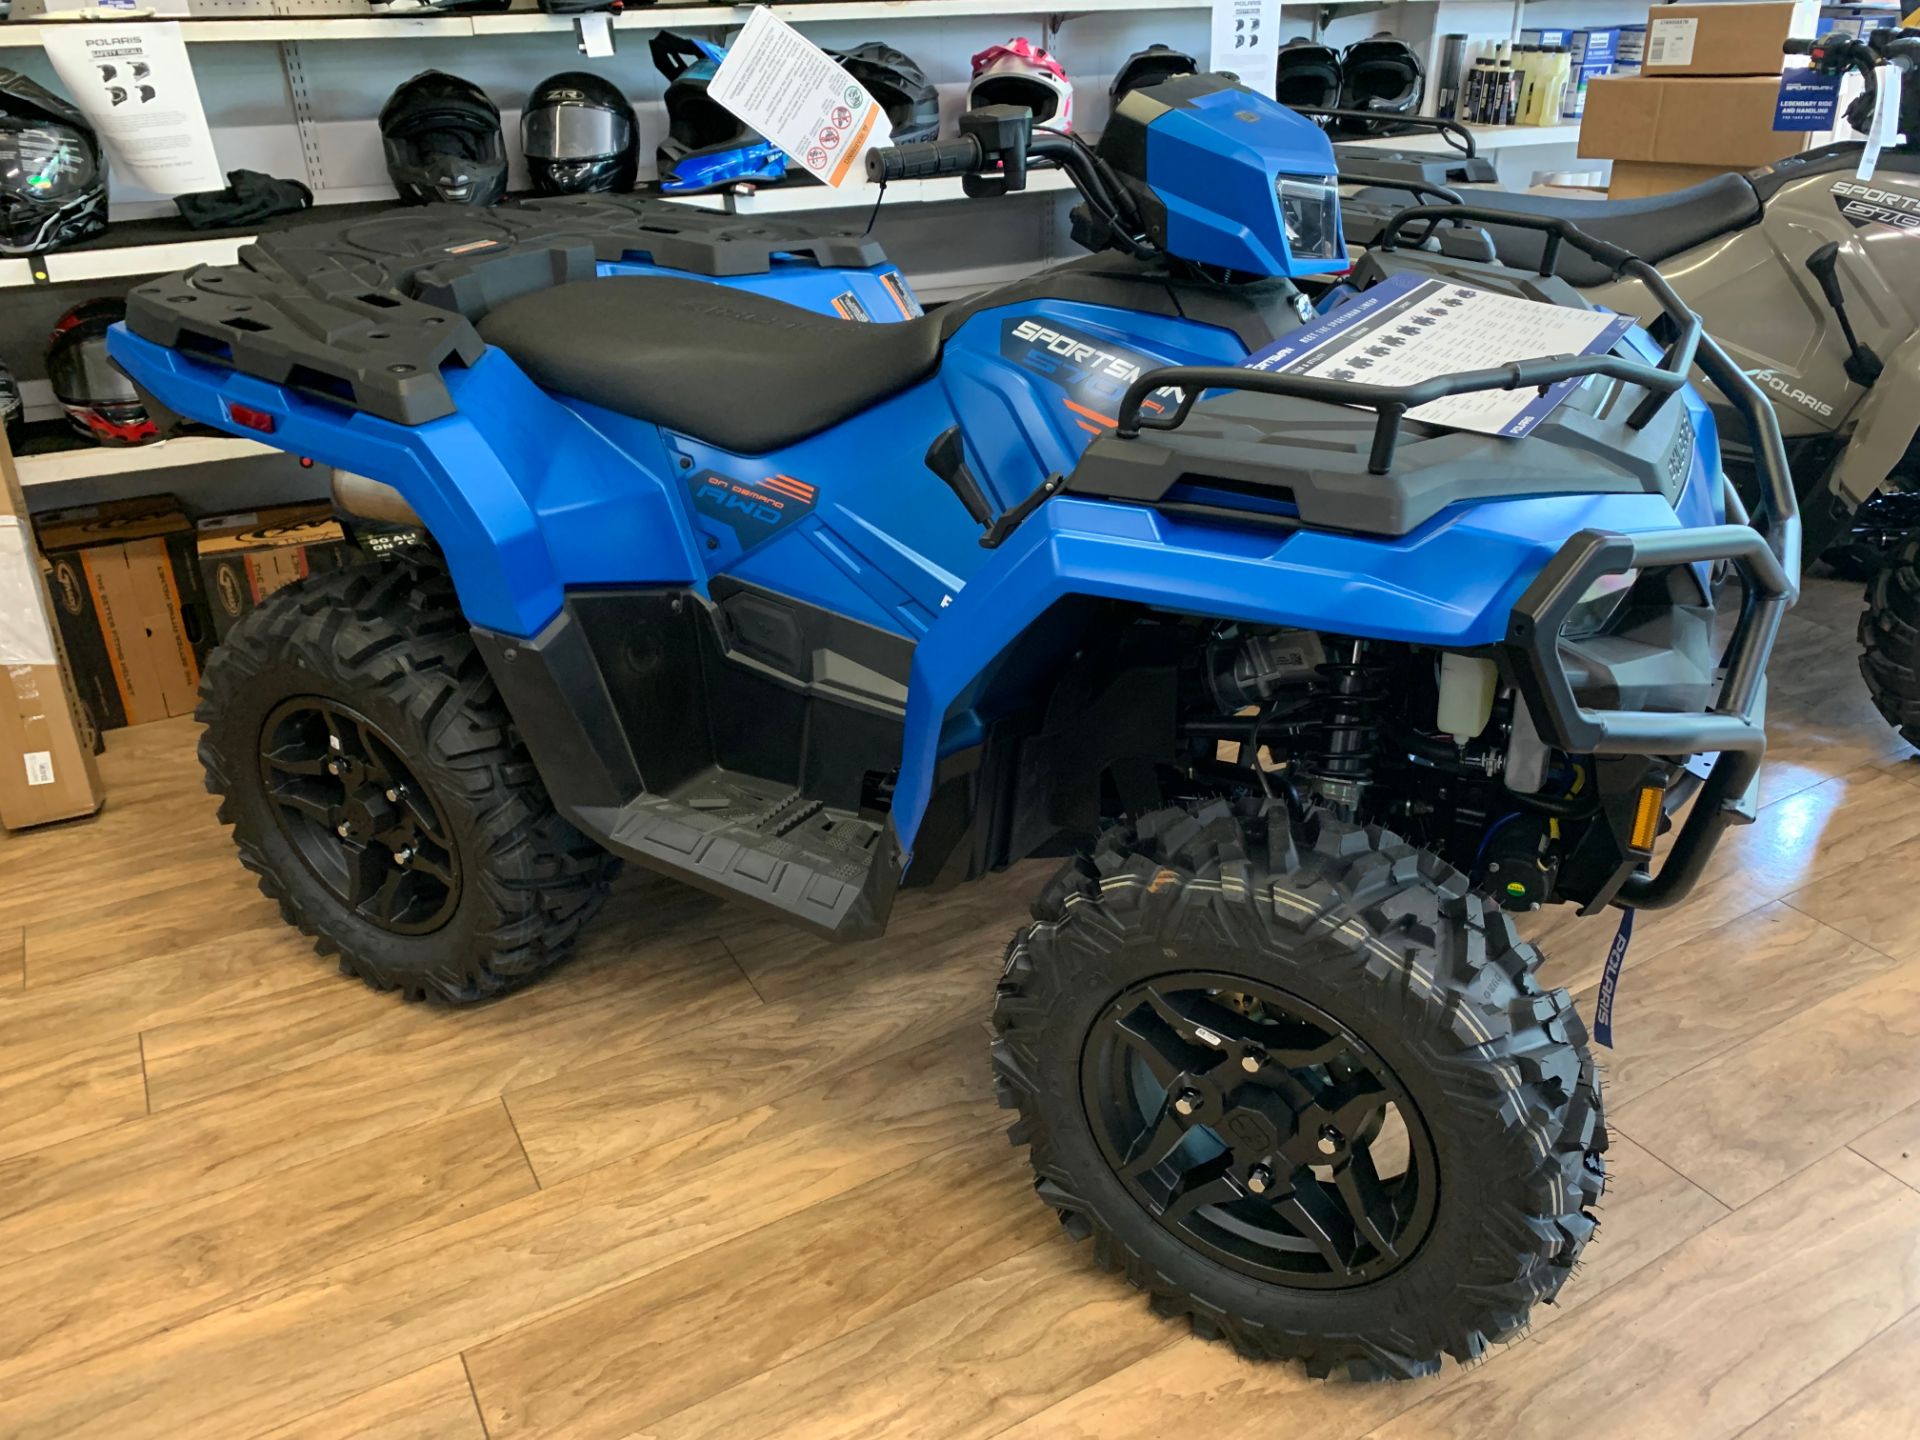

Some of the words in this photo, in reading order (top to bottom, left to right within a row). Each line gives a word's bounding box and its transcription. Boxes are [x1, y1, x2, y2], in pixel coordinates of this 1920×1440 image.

[85, 36, 142, 47] POLARIS
[1011, 320, 1187, 404] SPORTSMN
[1023, 349, 1128, 402] 570
[1756, 370, 1834, 417] POLARIS
[1509, 415, 1535, 435] POLARIS
[696, 485, 782, 525] AWD
[1597, 932, 1627, 1026] POLARIS
